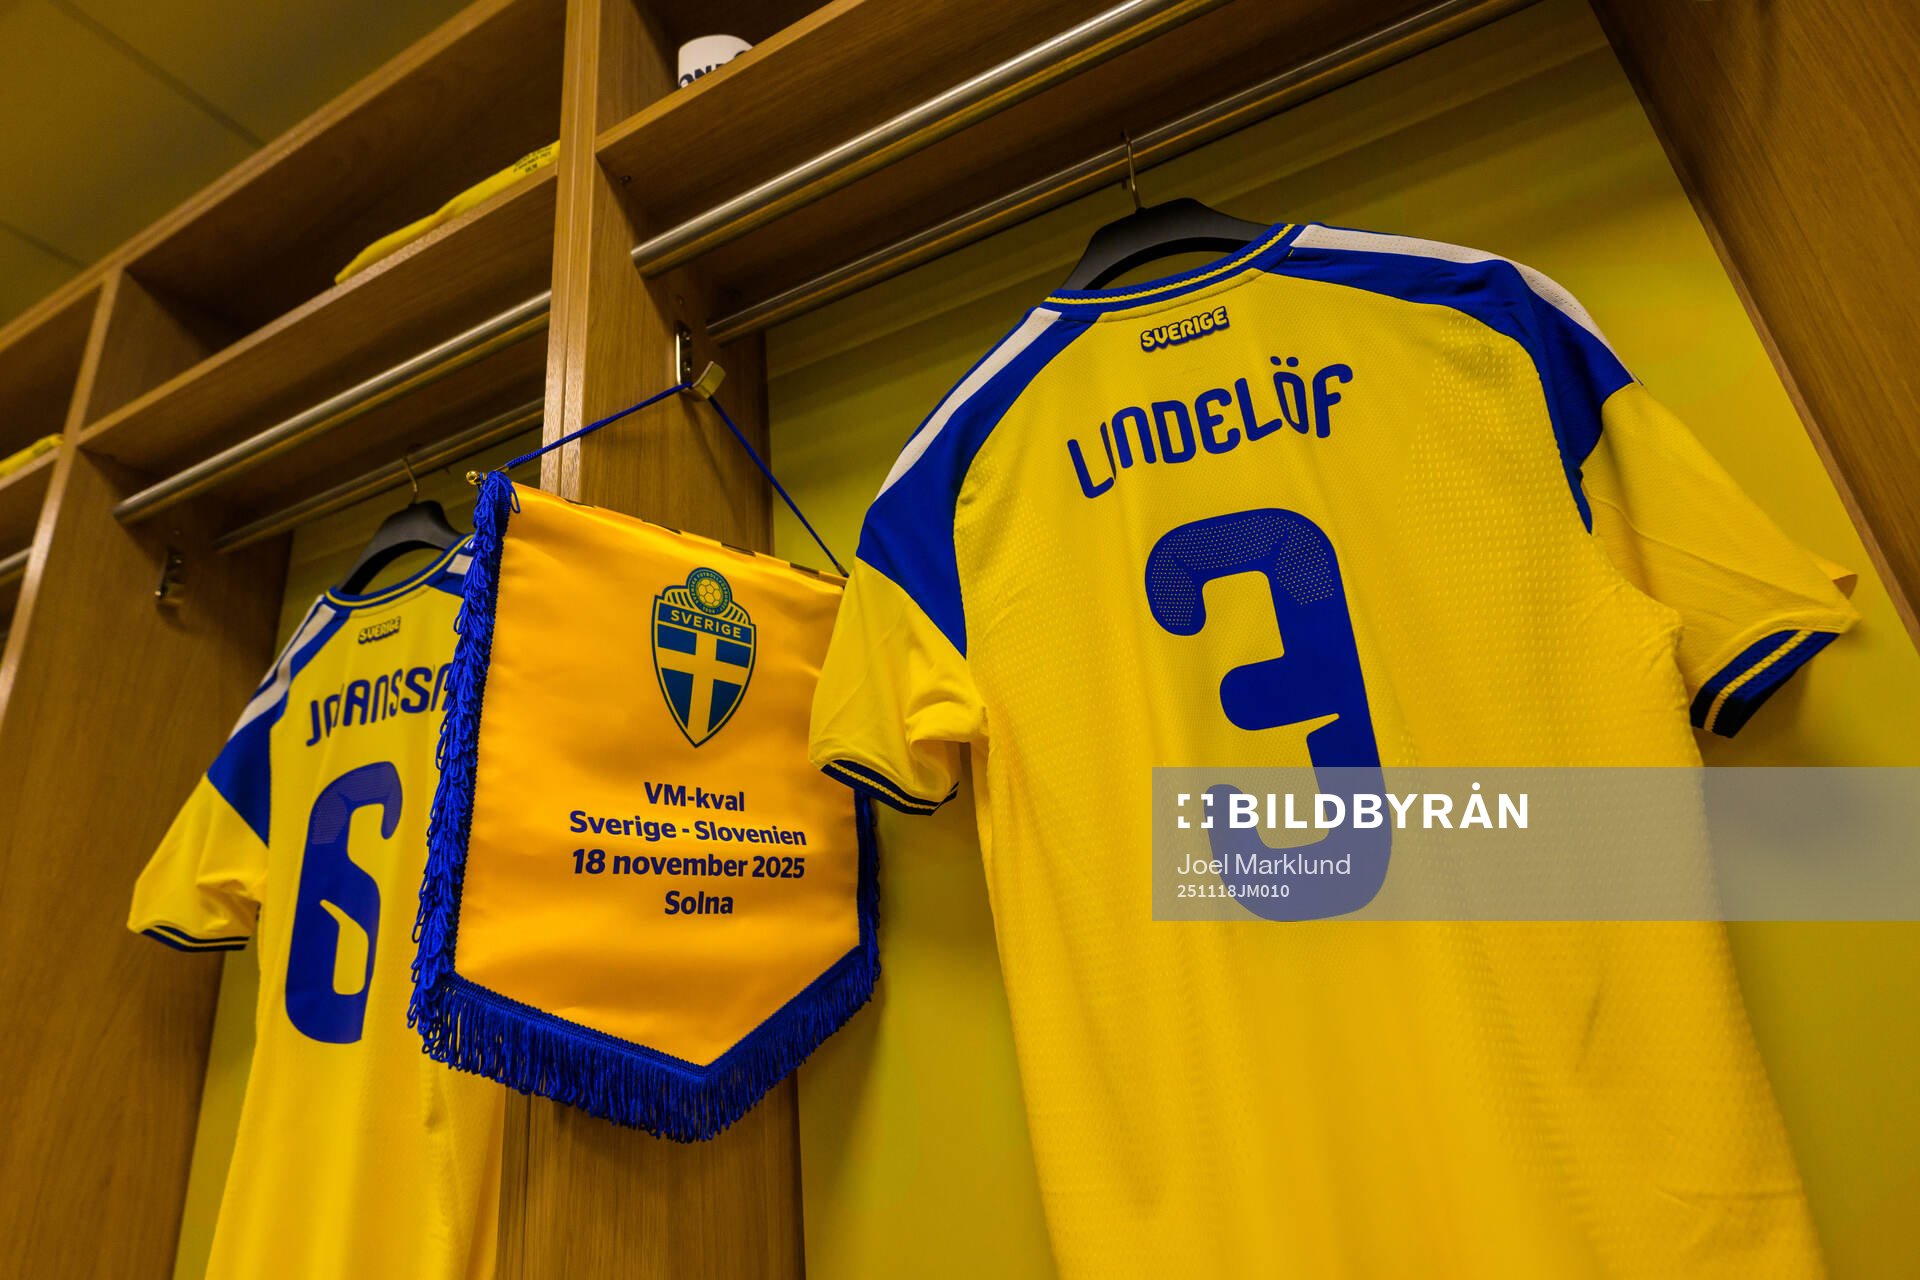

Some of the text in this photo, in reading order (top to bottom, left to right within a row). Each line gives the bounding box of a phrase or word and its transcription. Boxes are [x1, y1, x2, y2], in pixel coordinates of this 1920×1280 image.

[1140, 306, 1230, 352] SVERIGE
[670, 609, 742, 639] SVERIGE
[1144, 508, 1393, 922] 3
[644, 782, 745, 812] VM-kval
[569, 810, 677, 842] Sverige
[694, 820, 807, 846] Slovenien
[572, 848, 806, 879] 18 november 2025
[285, 761, 403, 1044] 6
[664, 890, 733, 915] Solna
